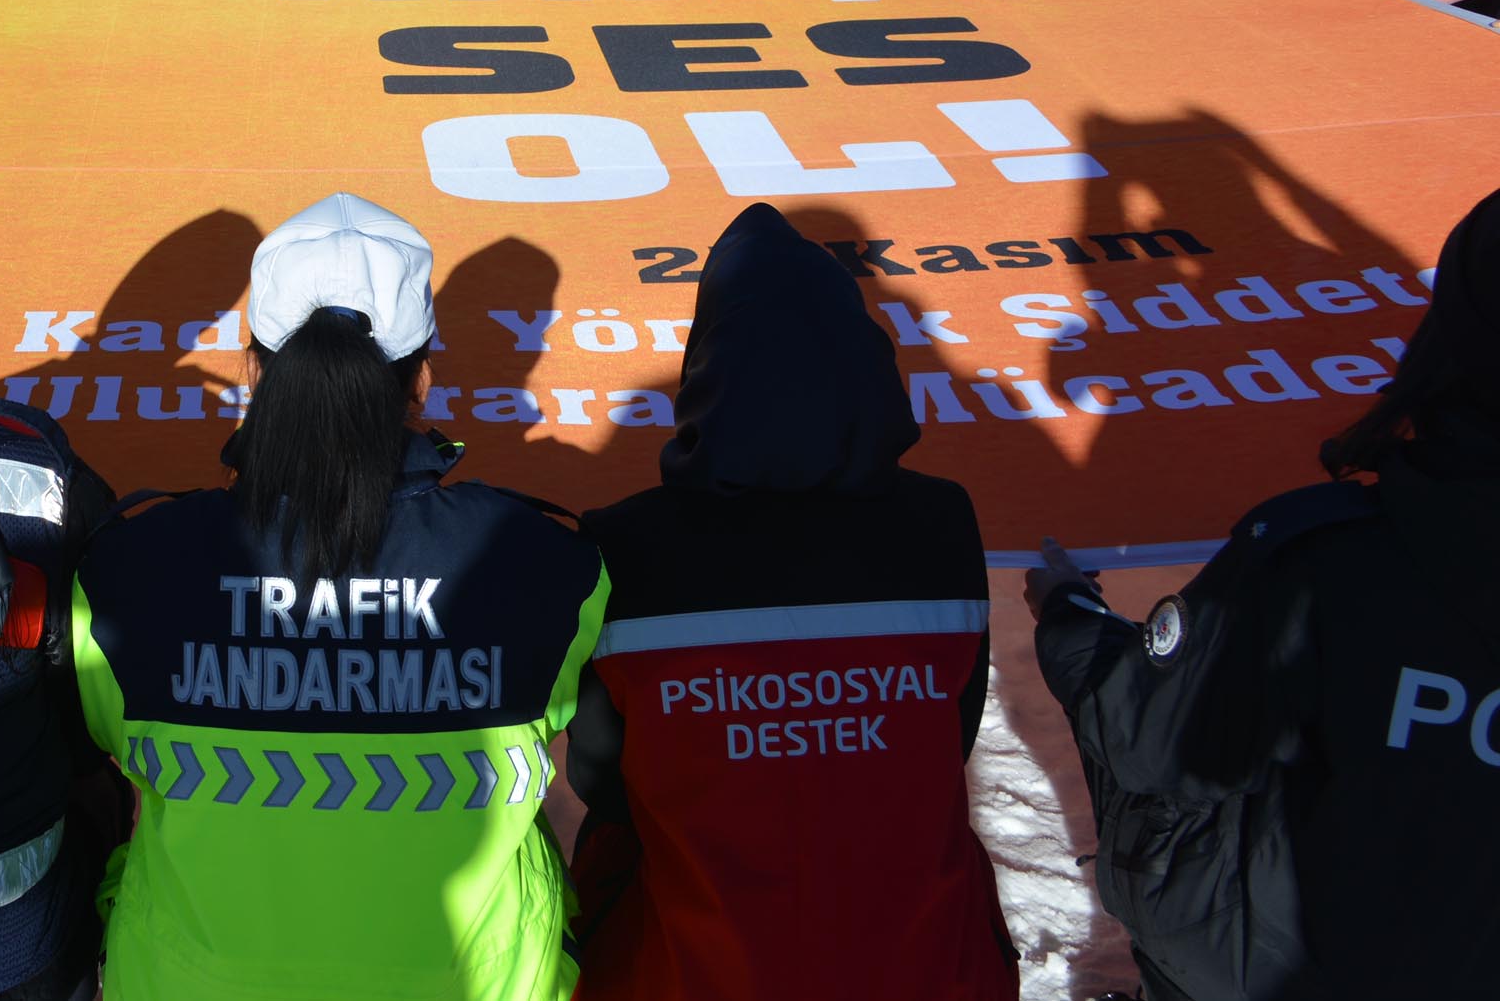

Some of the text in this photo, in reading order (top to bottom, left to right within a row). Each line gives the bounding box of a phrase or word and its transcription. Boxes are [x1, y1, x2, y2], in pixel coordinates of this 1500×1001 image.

[377, 17, 1031, 94] SES
[421, 98, 1109, 202] OL!
[824, 229, 1213, 279] Kasım
[171, 641, 502, 713] JANDARMASI
[660, 665, 947, 715] PSİKOSOSYAL
[726, 715, 888, 760] DESTEK
